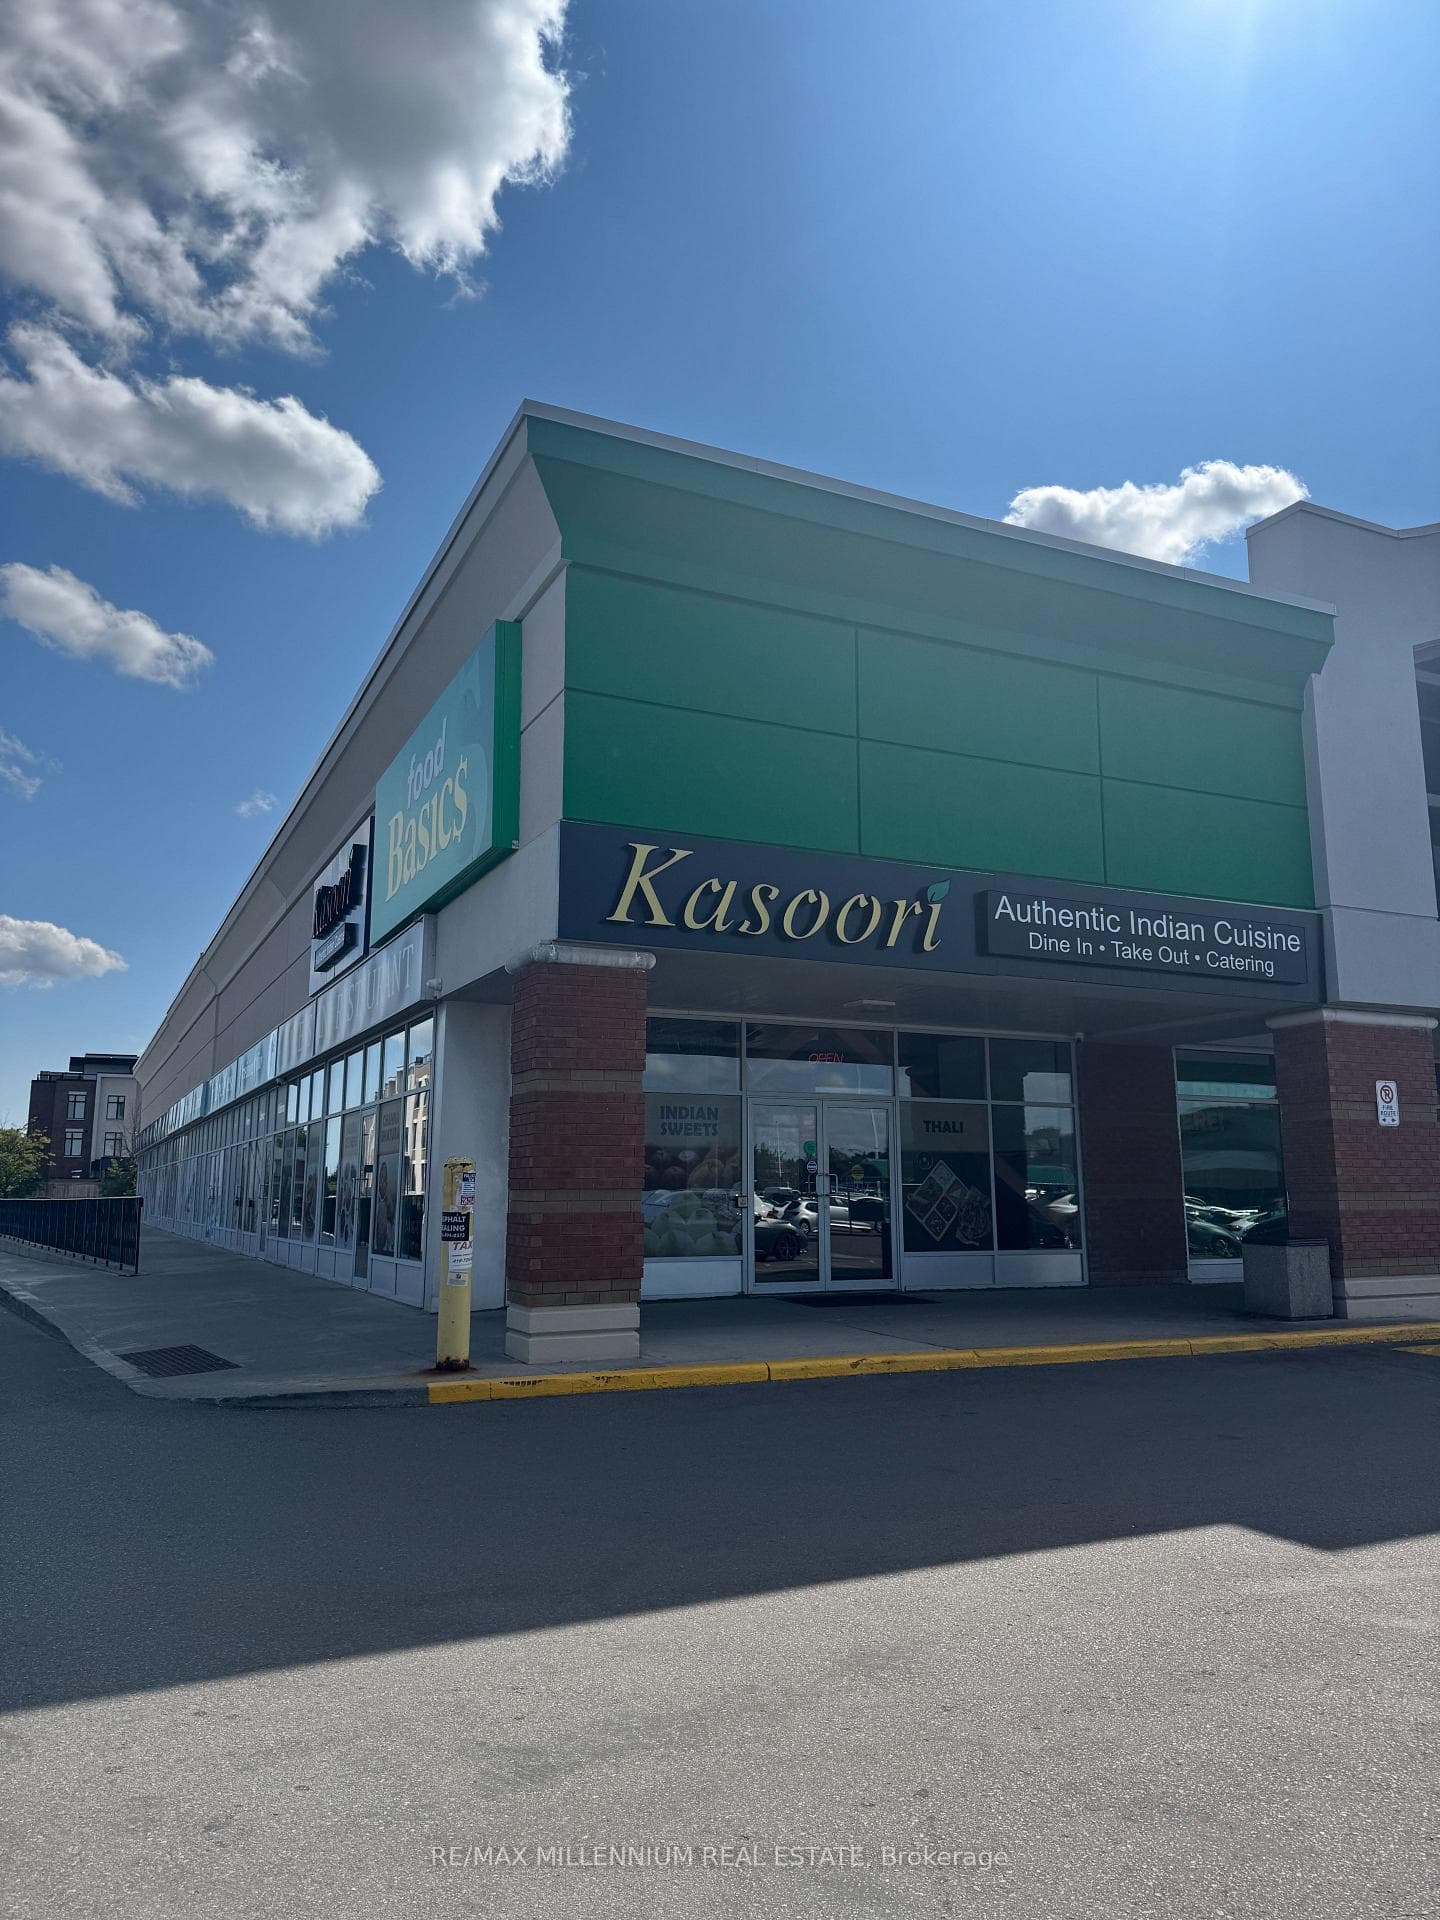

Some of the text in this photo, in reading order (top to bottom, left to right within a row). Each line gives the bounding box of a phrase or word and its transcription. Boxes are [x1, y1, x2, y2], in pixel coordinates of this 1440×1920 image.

[407, 715, 447, 809] food
[606, 842, 950, 952] Kasoori
[995, 895, 1301, 952] Authentic Indian Cuisine
[1029, 931, 1275, 977] Dine In Take Out Catering
[808, 1052, 844, 1064] OPEN
[659, 1105, 719, 1121] INDIAN
[923, 1120, 964, 1134] THALI
[659, 1122, 719, 1137] SWEETS
